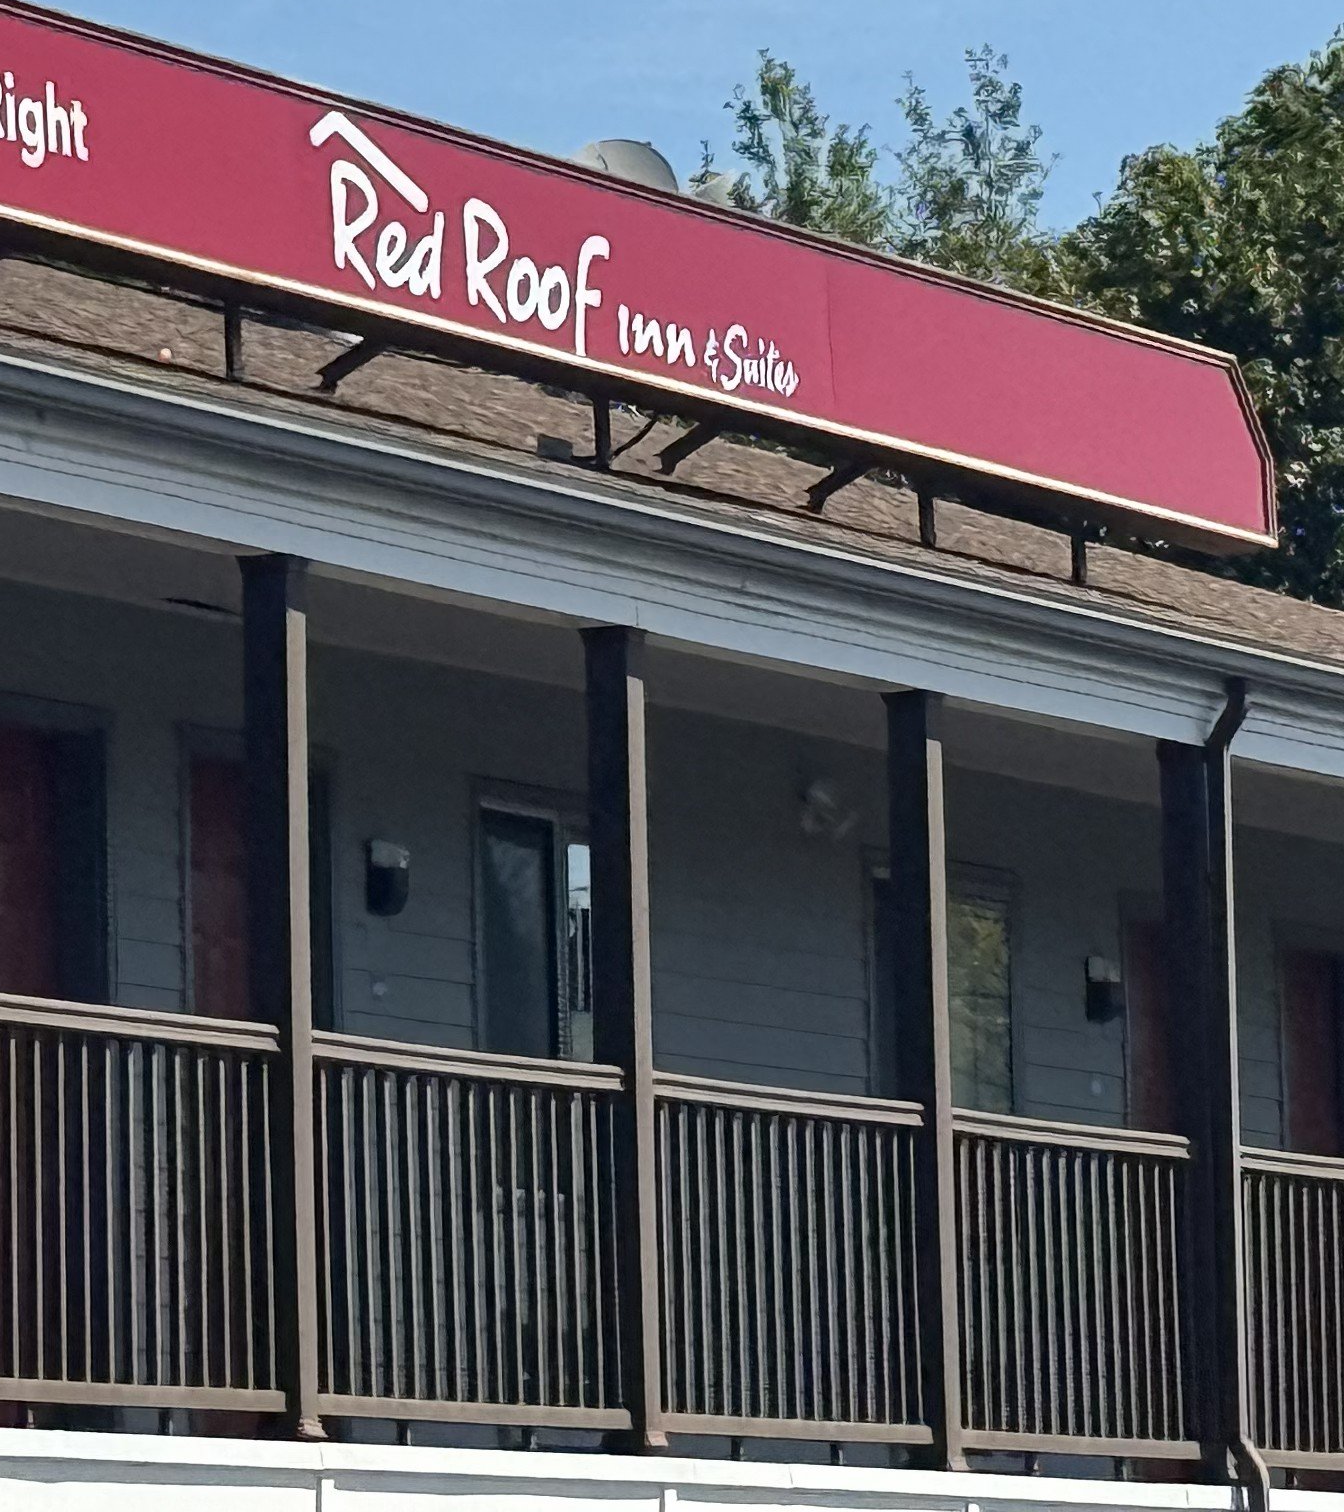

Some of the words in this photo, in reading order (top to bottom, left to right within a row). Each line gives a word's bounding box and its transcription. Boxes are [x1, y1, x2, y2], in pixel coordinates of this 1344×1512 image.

[330, 159, 445, 300] Red
[463, 197, 610, 357] Roof
[720, 323, 801, 398] Suites
